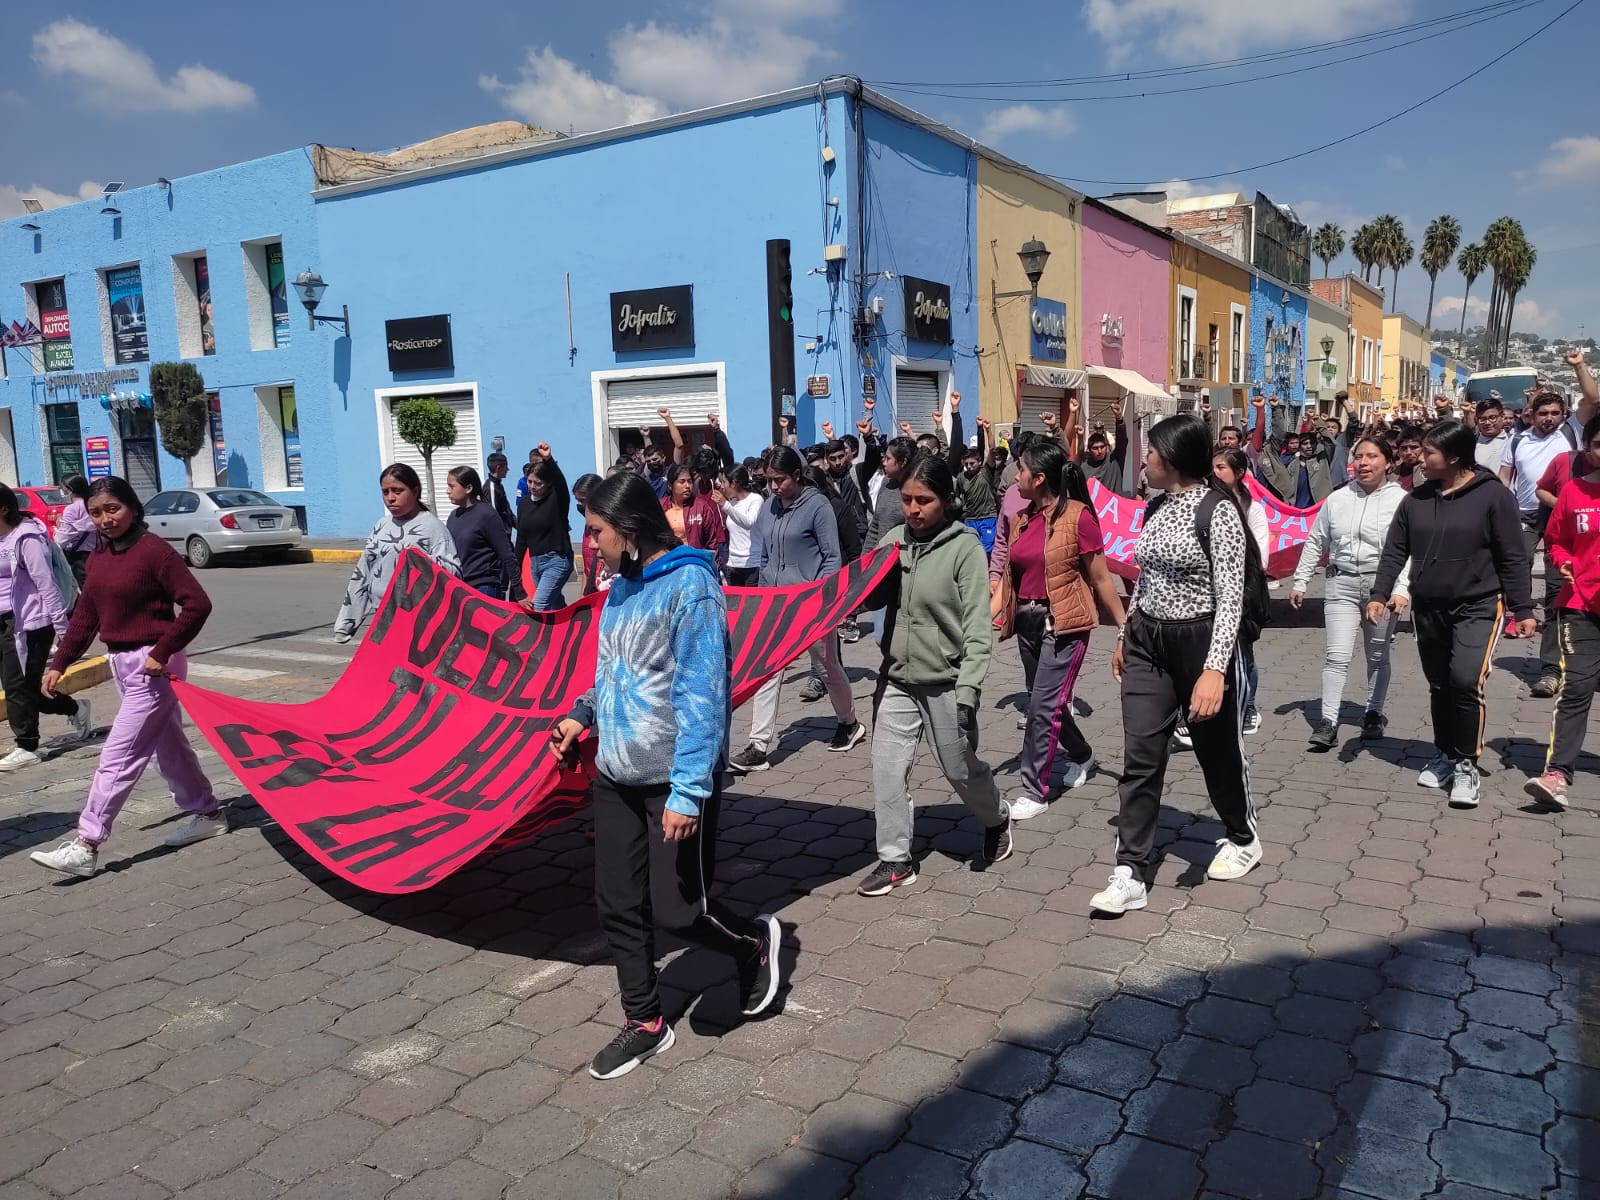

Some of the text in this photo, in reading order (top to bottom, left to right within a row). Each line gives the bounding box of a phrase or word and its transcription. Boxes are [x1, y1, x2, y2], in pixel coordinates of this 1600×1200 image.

[618, 304, 677, 335] Jofralix
[369, 550, 593, 710] PUEBLO
[324, 665, 460, 766] TU
